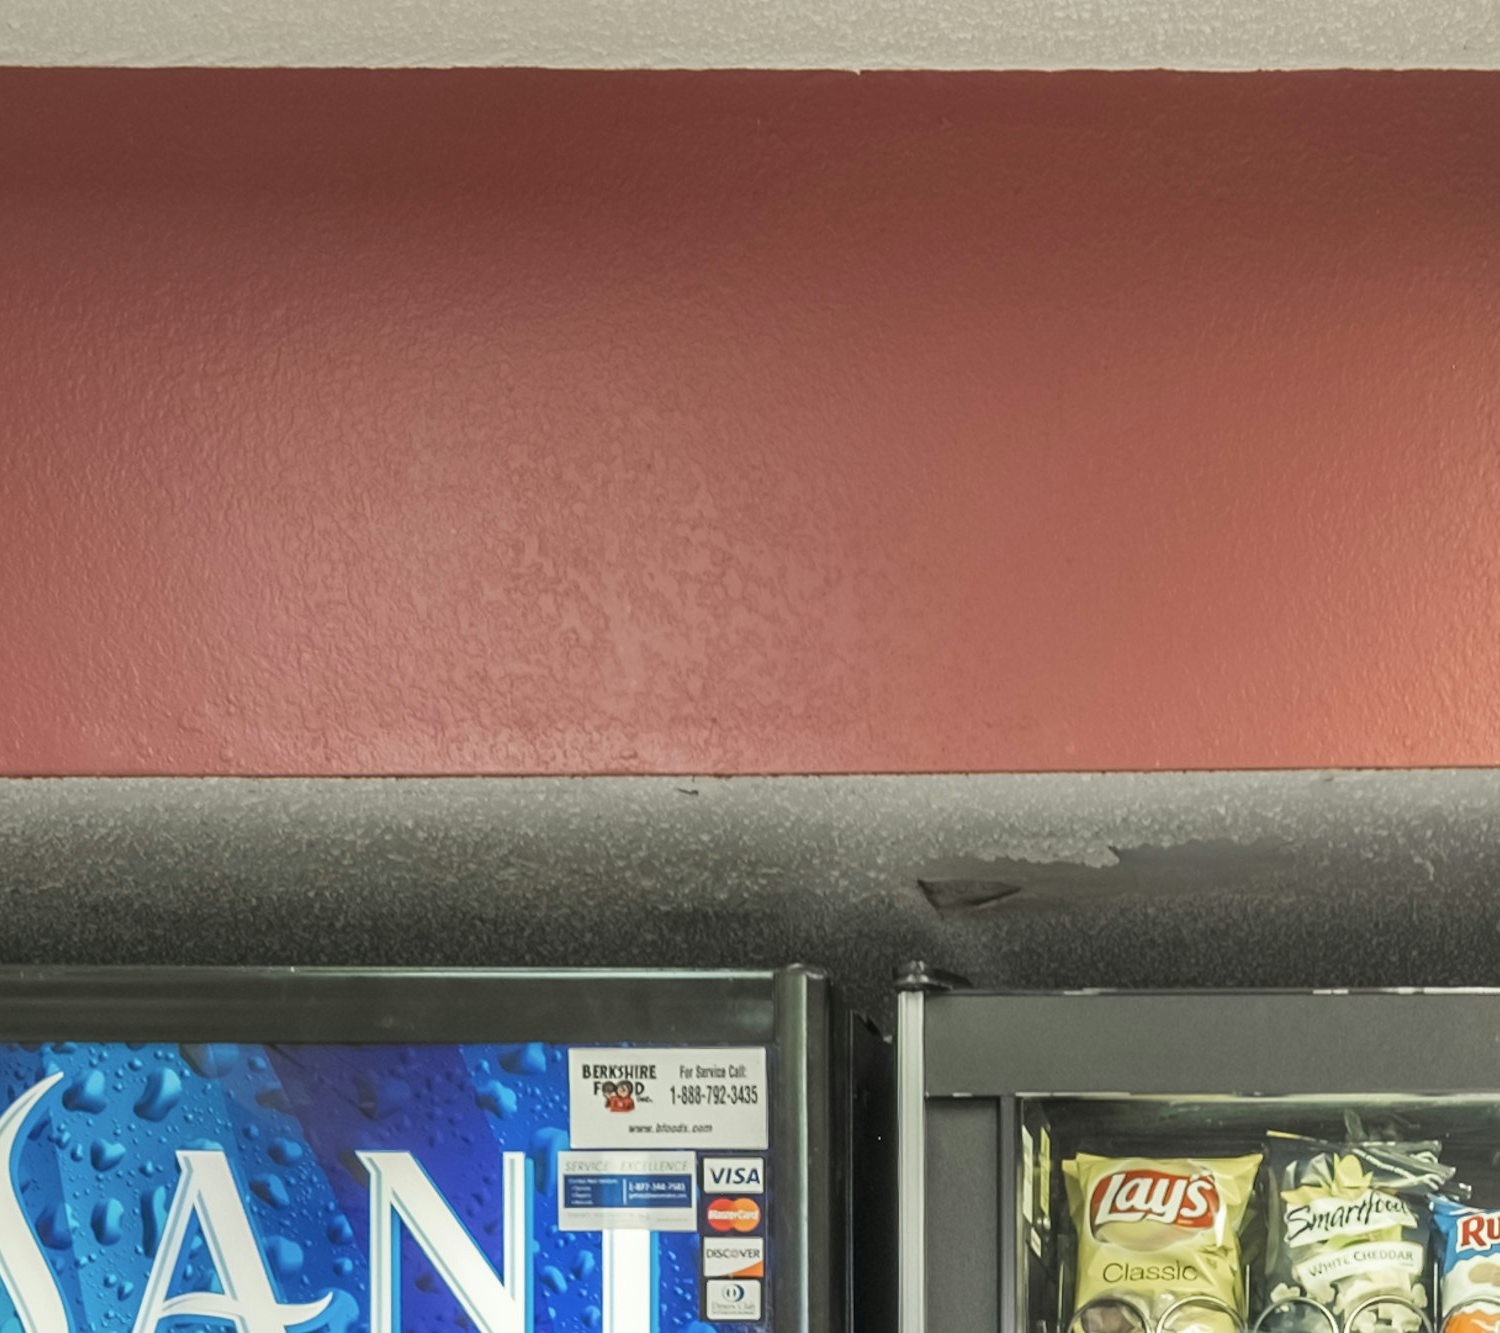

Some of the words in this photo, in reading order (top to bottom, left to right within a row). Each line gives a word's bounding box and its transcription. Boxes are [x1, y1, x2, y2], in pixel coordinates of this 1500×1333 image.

[582, 1064, 657, 1079] BERKSHIRE
[680, 1065, 694, 1078] For
[696, 1065, 726, 1078] Service
[670, 1085, 759, 1105] 1-888-792-3435
[565, 1161, 609, 1172] SERVICE
[621, 1160, 689, 1172] EXCELLENCE
[710, 1167, 761, 1185] VISA
[1094, 1170, 1215, 1229] Lay's
[1287, 1190, 1409, 1239] Smartfood
[706, 1247, 761, 1260] DISCOVER
[1102, 1260, 1200, 1284] Classic
[1307, 1255, 1349, 1279] WHITE
[1352, 1249, 1414, 1265] CHEDDAR
